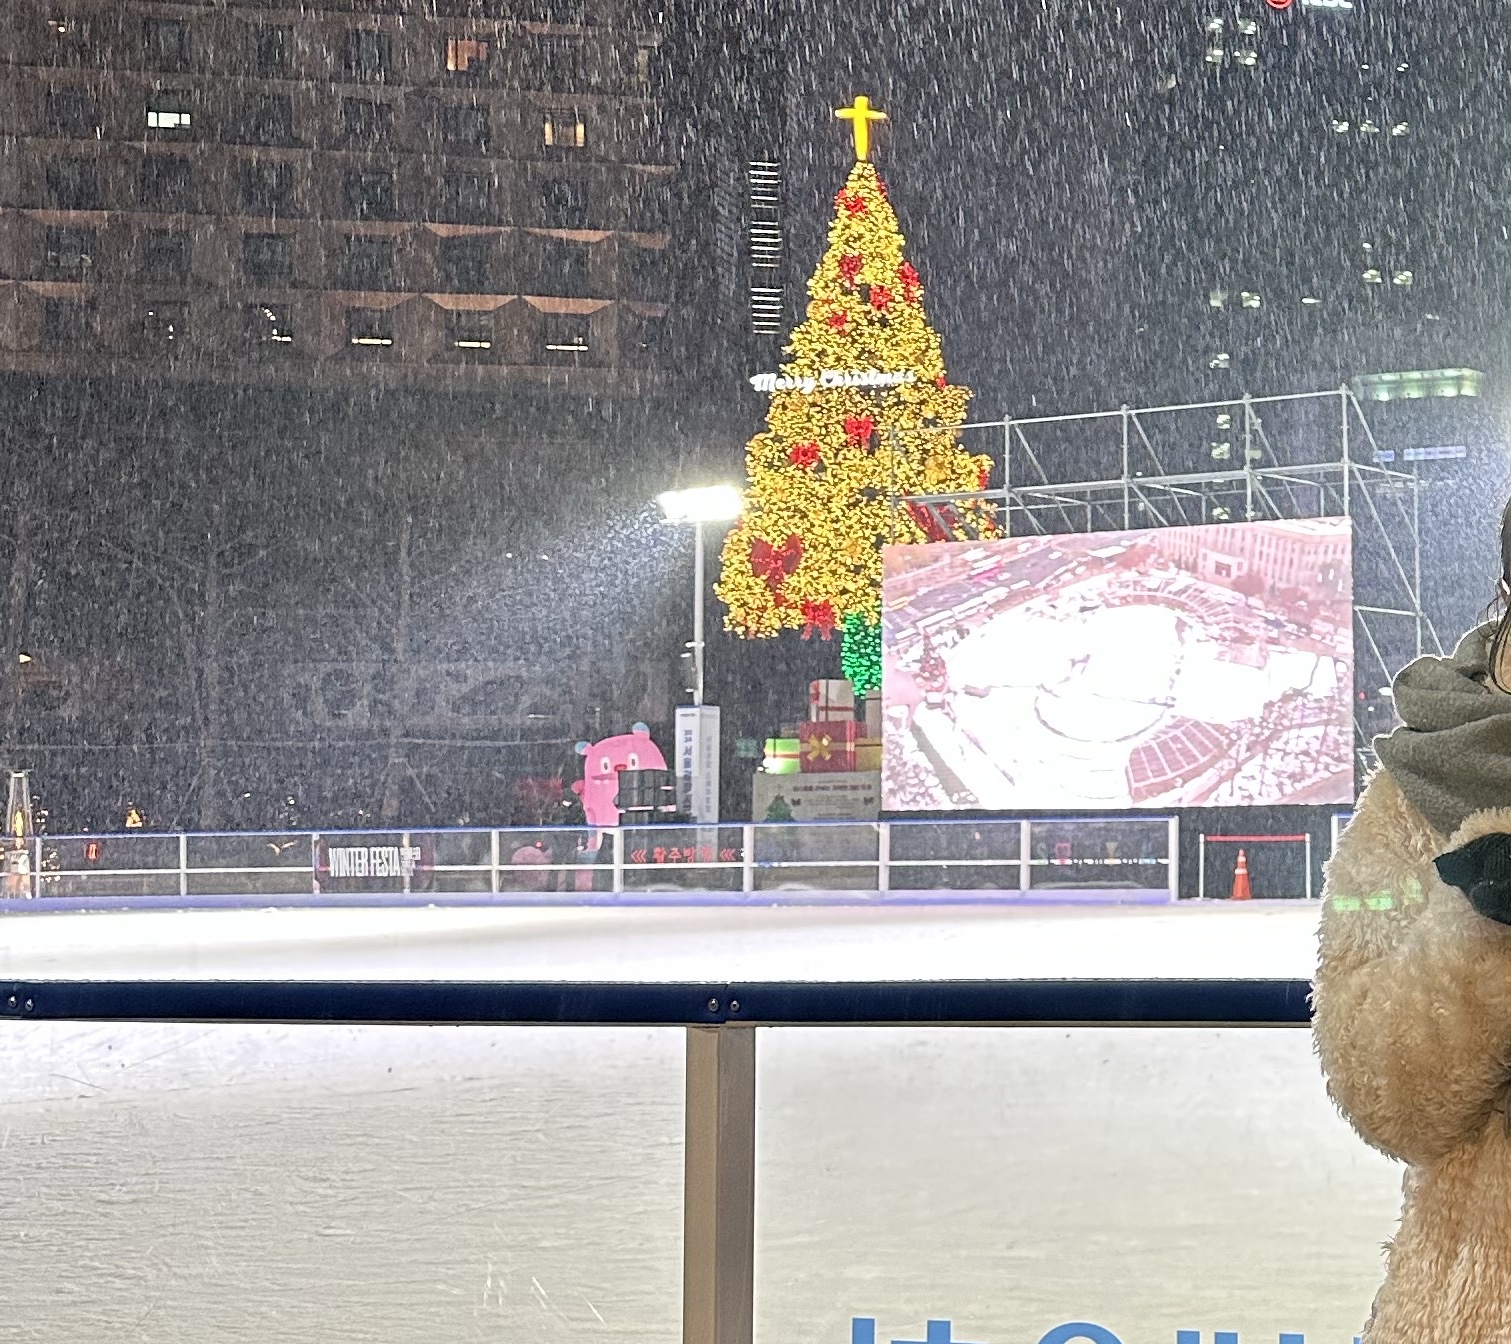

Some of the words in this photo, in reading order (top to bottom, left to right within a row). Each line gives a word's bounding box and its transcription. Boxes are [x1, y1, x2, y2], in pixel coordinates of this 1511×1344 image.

[750, 372, 817, 394] Merry
[819, 368, 917, 388] Christmas
[328, 846, 369, 877] WINTER
[369, 846, 401, 877] FESTA
